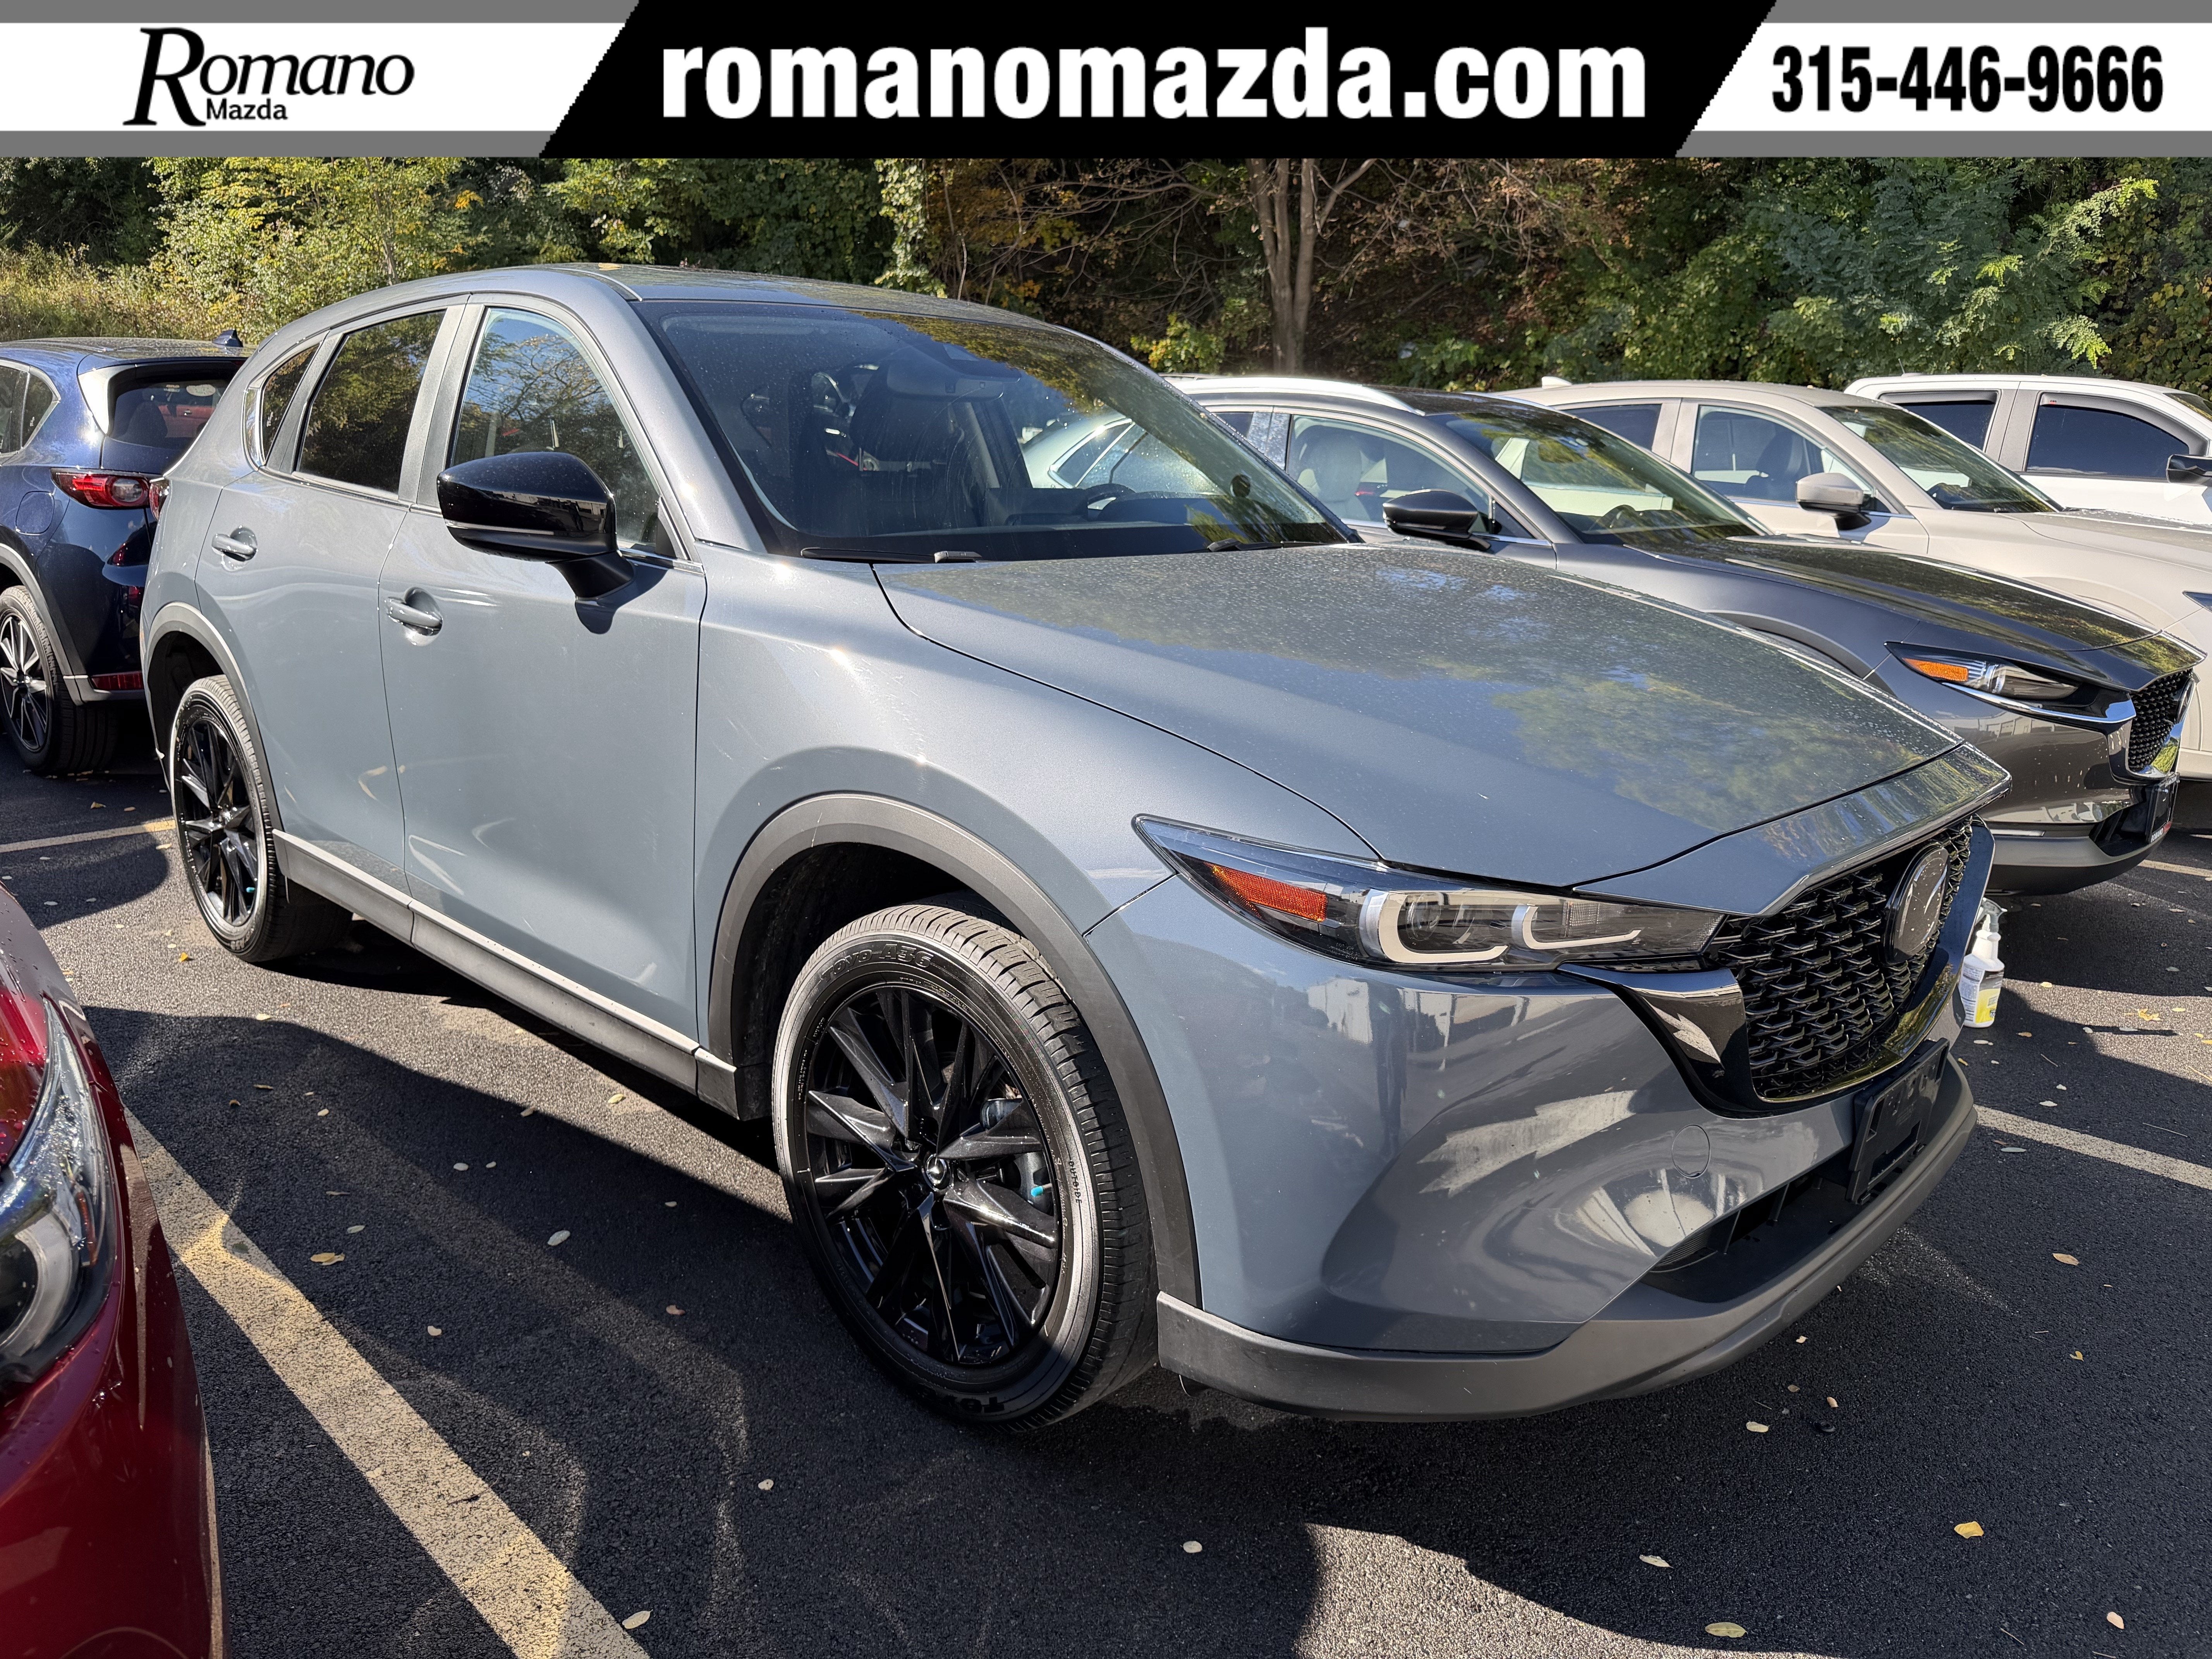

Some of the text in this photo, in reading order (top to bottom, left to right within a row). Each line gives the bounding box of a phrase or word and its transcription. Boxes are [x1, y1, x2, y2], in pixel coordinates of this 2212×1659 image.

[819, 944, 934, 982] TOYO A36
[1069, 1159, 1083, 1204] OUTSIDE
